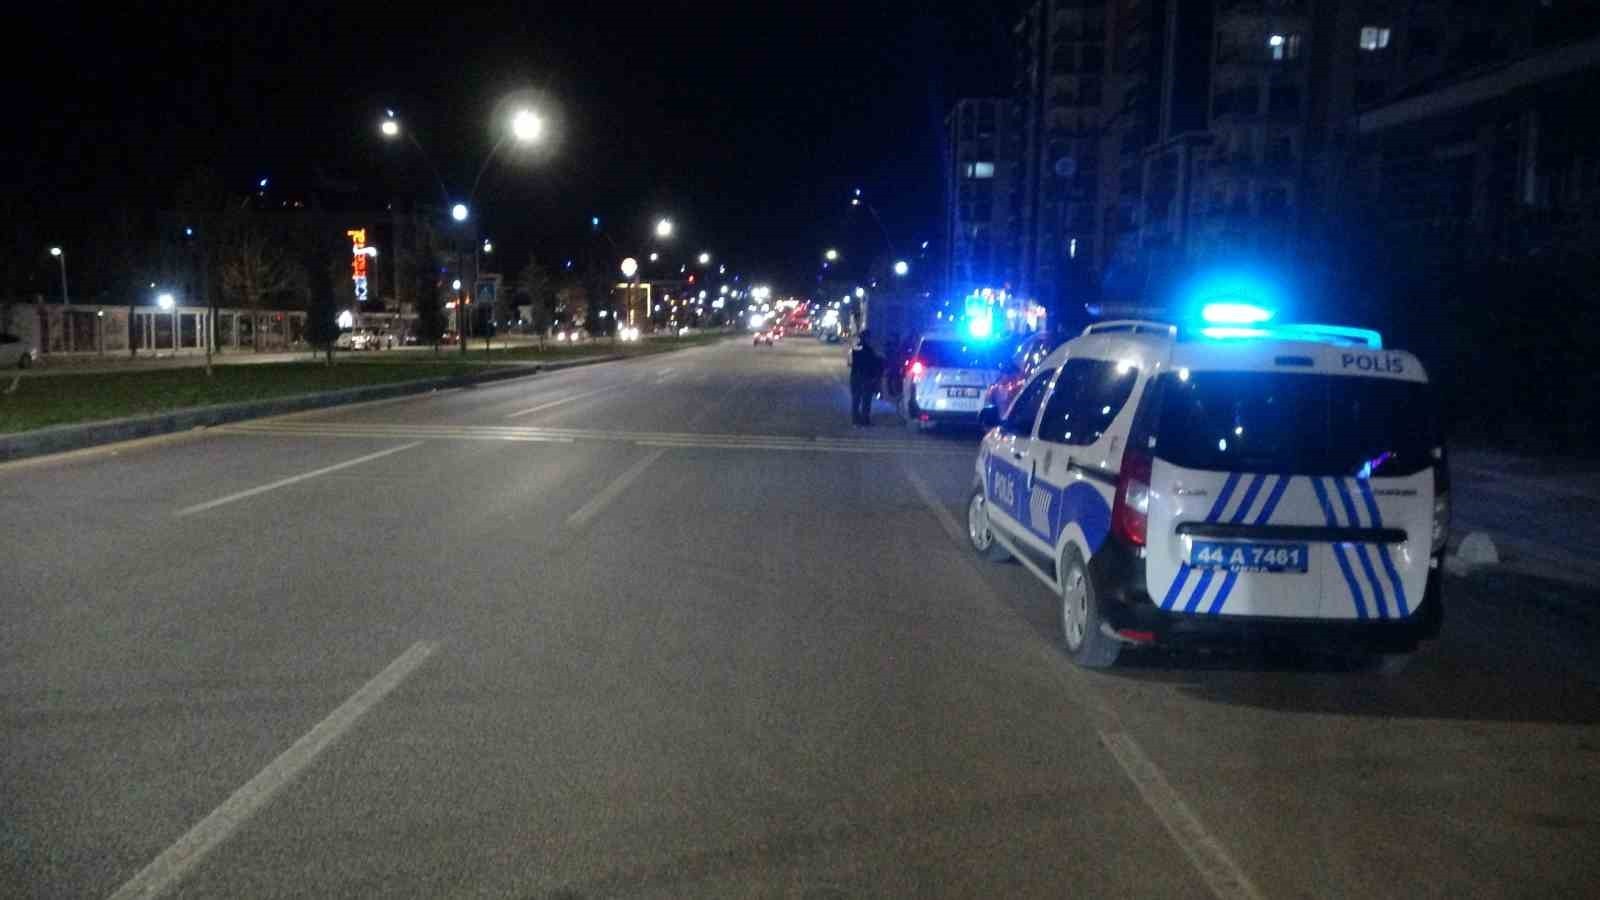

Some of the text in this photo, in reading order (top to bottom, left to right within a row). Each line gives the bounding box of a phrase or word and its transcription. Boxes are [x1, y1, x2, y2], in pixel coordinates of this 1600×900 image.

[1342, 353, 1403, 373] POLİS
[1198, 547, 1299, 565] 44 A 7461
